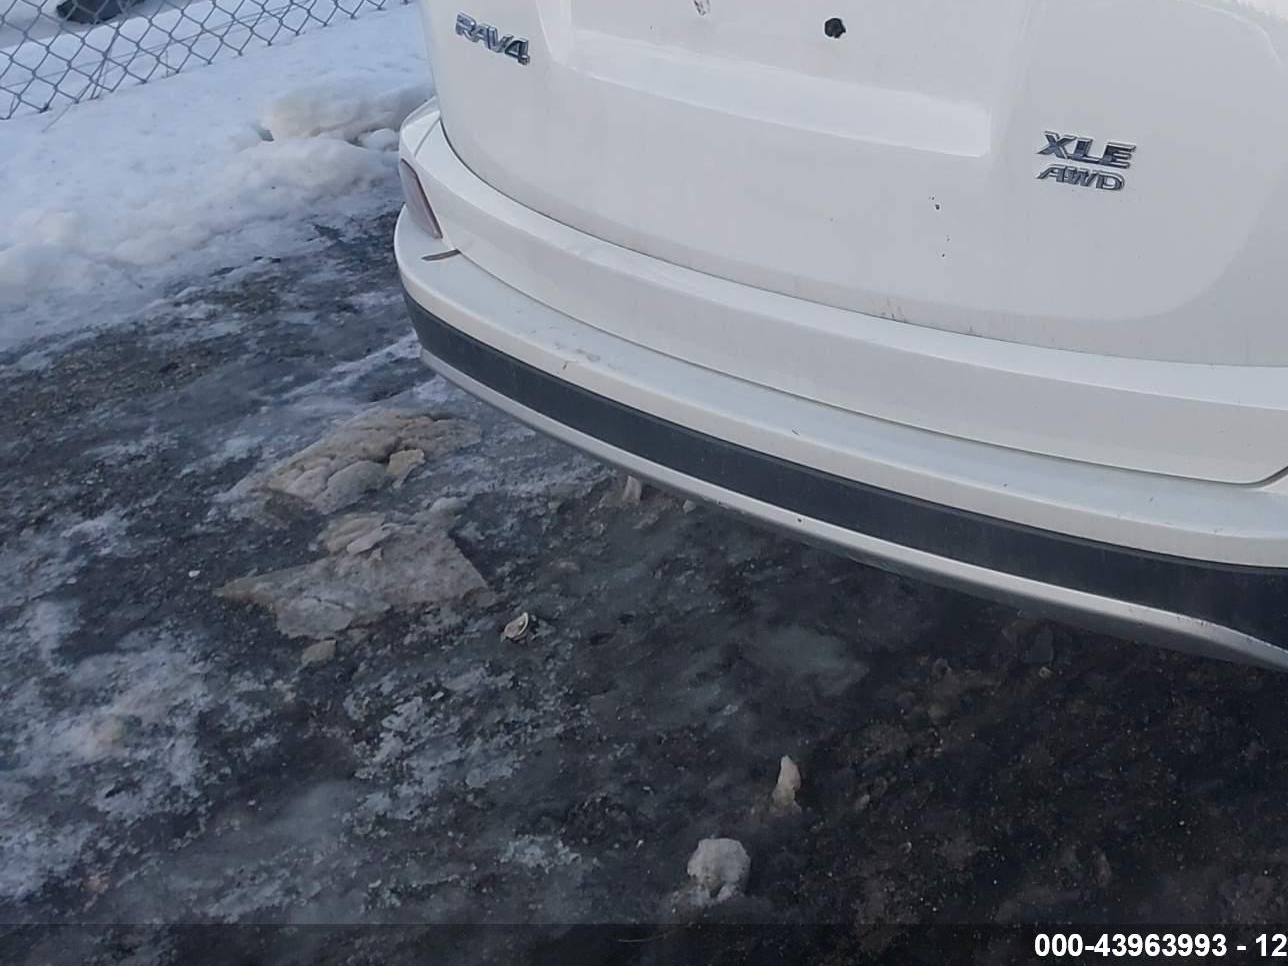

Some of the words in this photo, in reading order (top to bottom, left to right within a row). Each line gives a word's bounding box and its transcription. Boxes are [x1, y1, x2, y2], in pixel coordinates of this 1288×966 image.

[455, 11, 530, 66] RAV4
[1037, 130, 1137, 170] XLE
[1035, 164, 1125, 191] AWD
